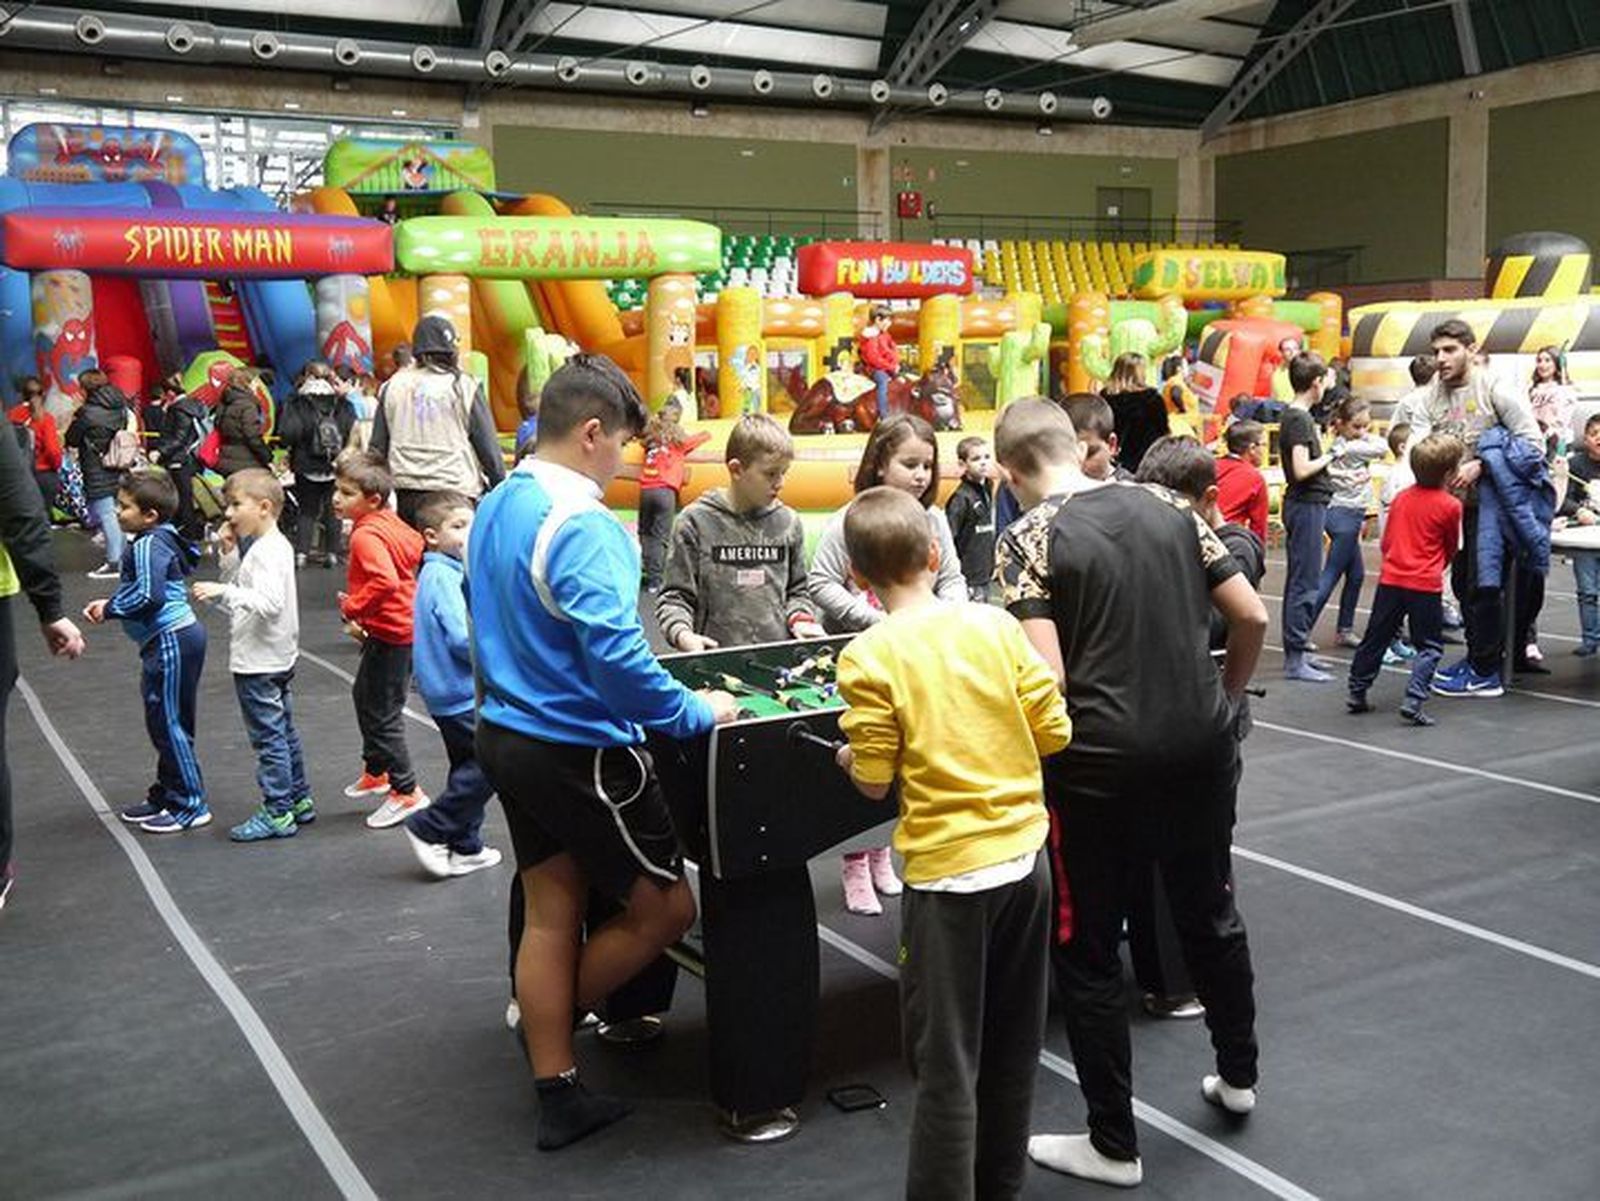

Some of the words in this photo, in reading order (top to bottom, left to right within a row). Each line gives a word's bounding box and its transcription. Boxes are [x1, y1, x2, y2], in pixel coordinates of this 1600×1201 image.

[478, 227, 658, 269] GRANJA
[837, 257, 878, 285] FUN
[719, 547, 779, 561] AMERICAN
